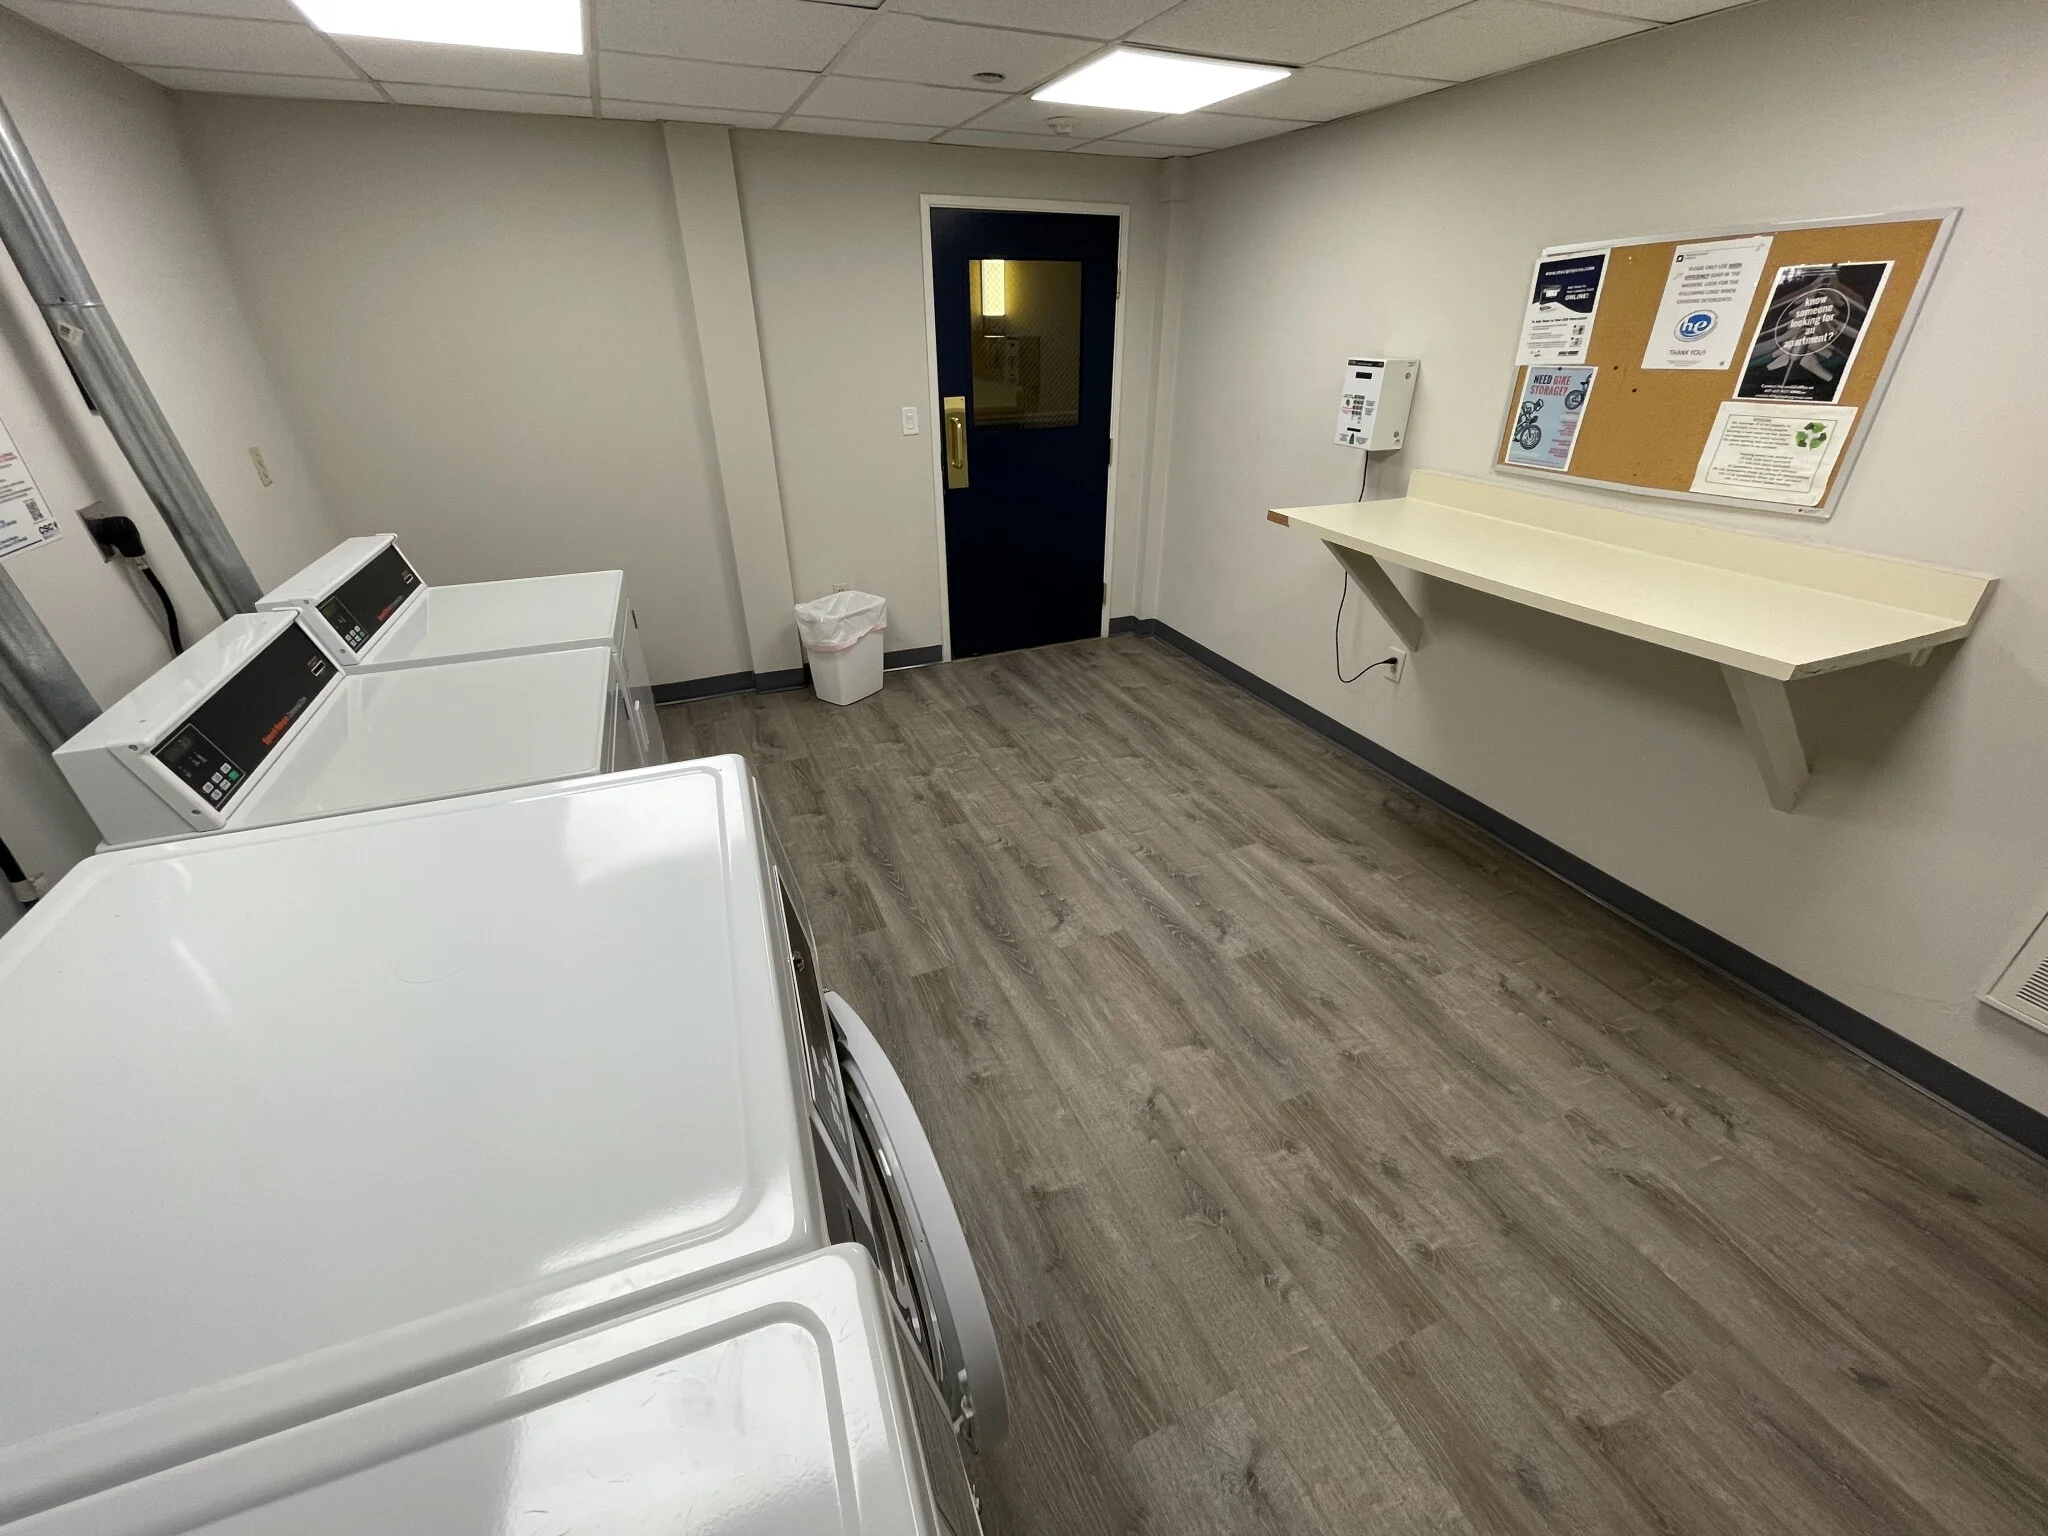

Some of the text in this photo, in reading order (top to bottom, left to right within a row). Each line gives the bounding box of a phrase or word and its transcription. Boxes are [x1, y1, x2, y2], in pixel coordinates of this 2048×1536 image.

[1564, 293, 1589, 301] ONLINE!
[1805, 296, 1828, 307] know
[1795, 304, 1834, 319] someone
[1682, 320, 1707, 333] he
[1790, 313, 1836, 329] looking for
[1804, 327, 1816, 336] an
[1783, 331, 1834, 350] apartment?
[1533, 374, 1572, 386] NEED BIKE
[1530, 385, 1569, 397] STORAGE?
[38, 523, 55, 535] CSC
